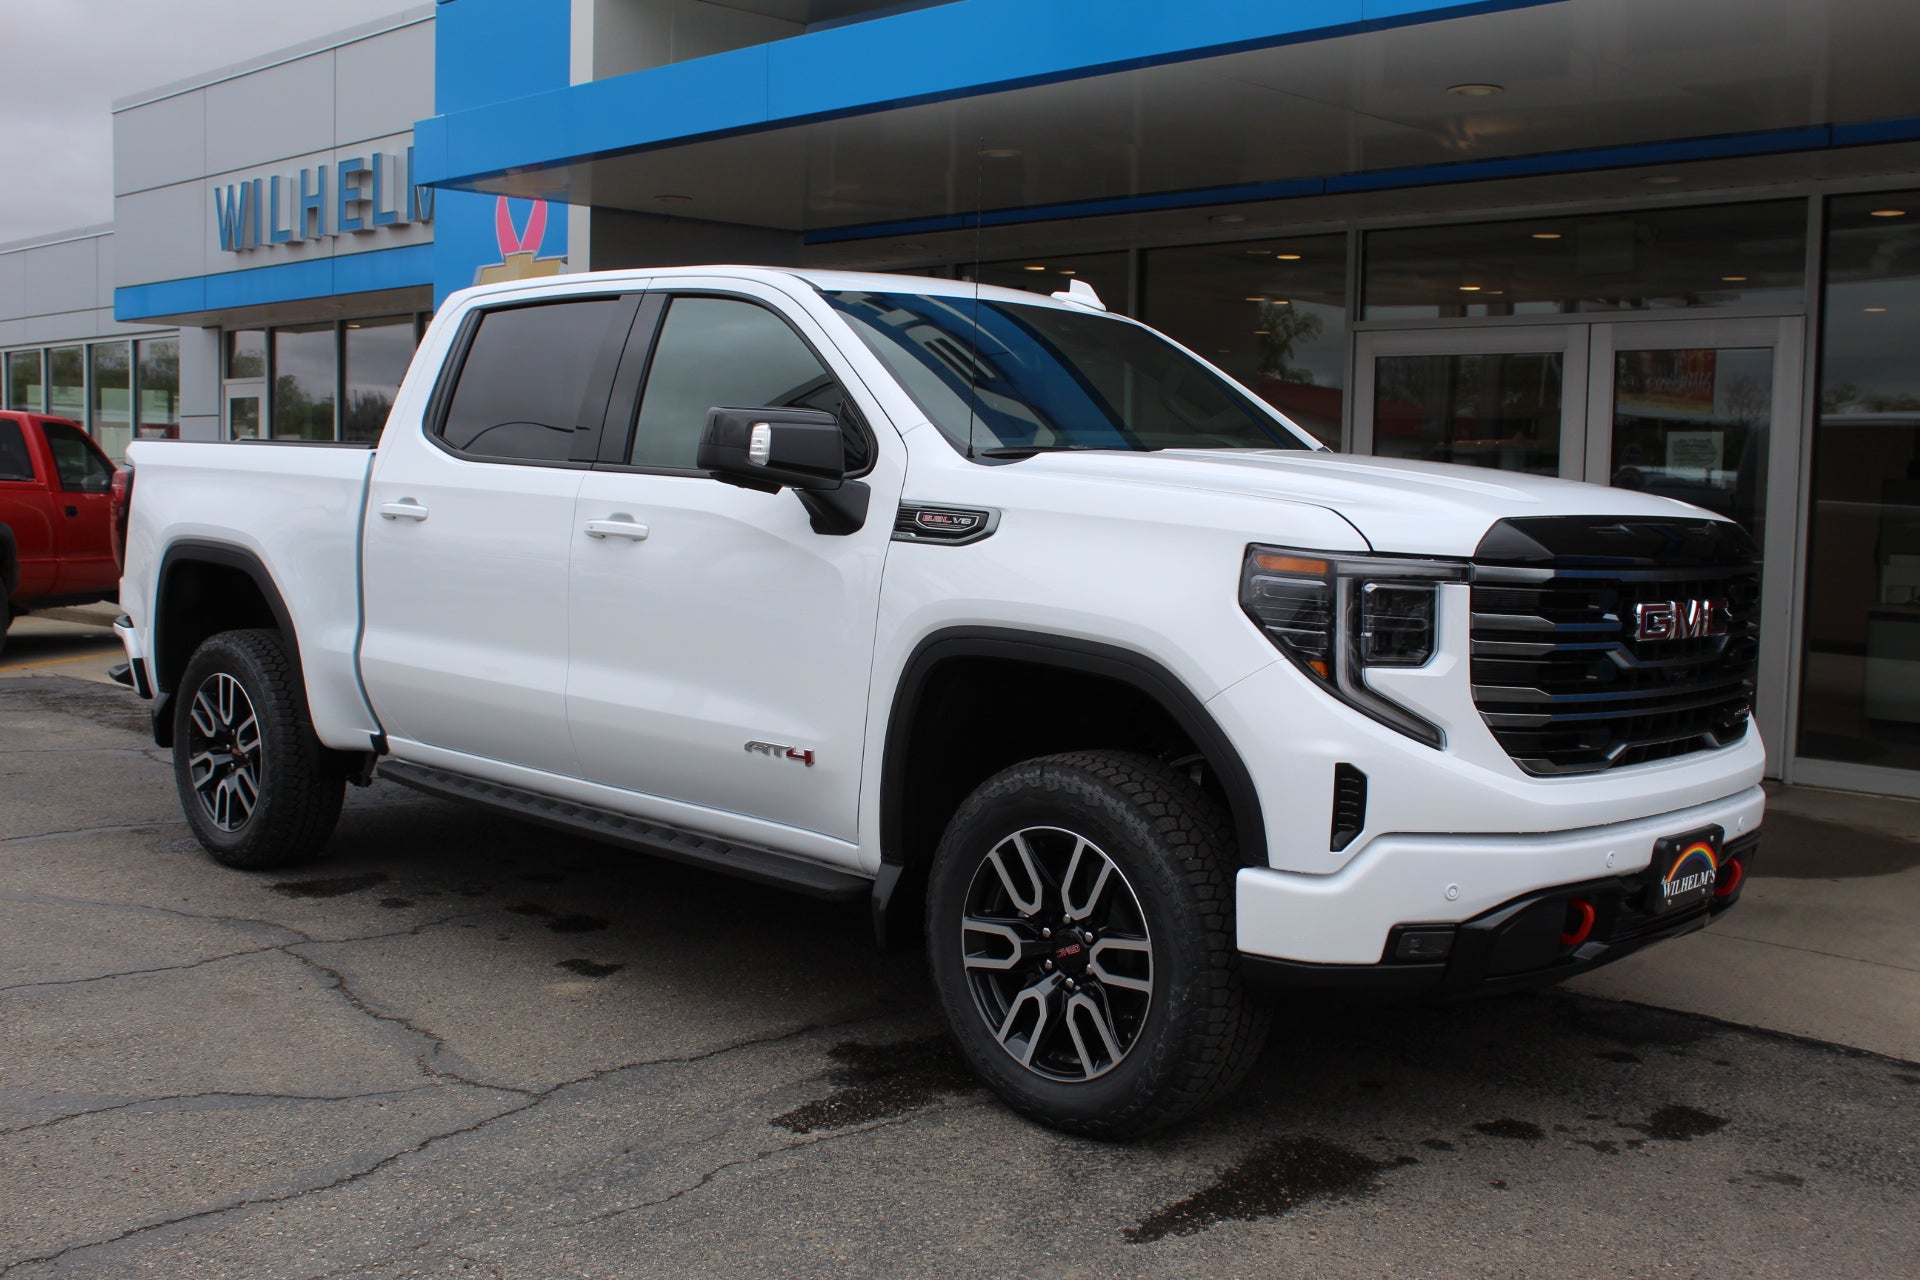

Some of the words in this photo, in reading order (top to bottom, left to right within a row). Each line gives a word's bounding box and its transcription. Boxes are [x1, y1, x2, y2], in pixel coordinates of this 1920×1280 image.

[1635, 599, 1732, 642] GMC
[744, 740, 816, 767] AT4
[1661, 867, 1717, 899] WILHELM'S
